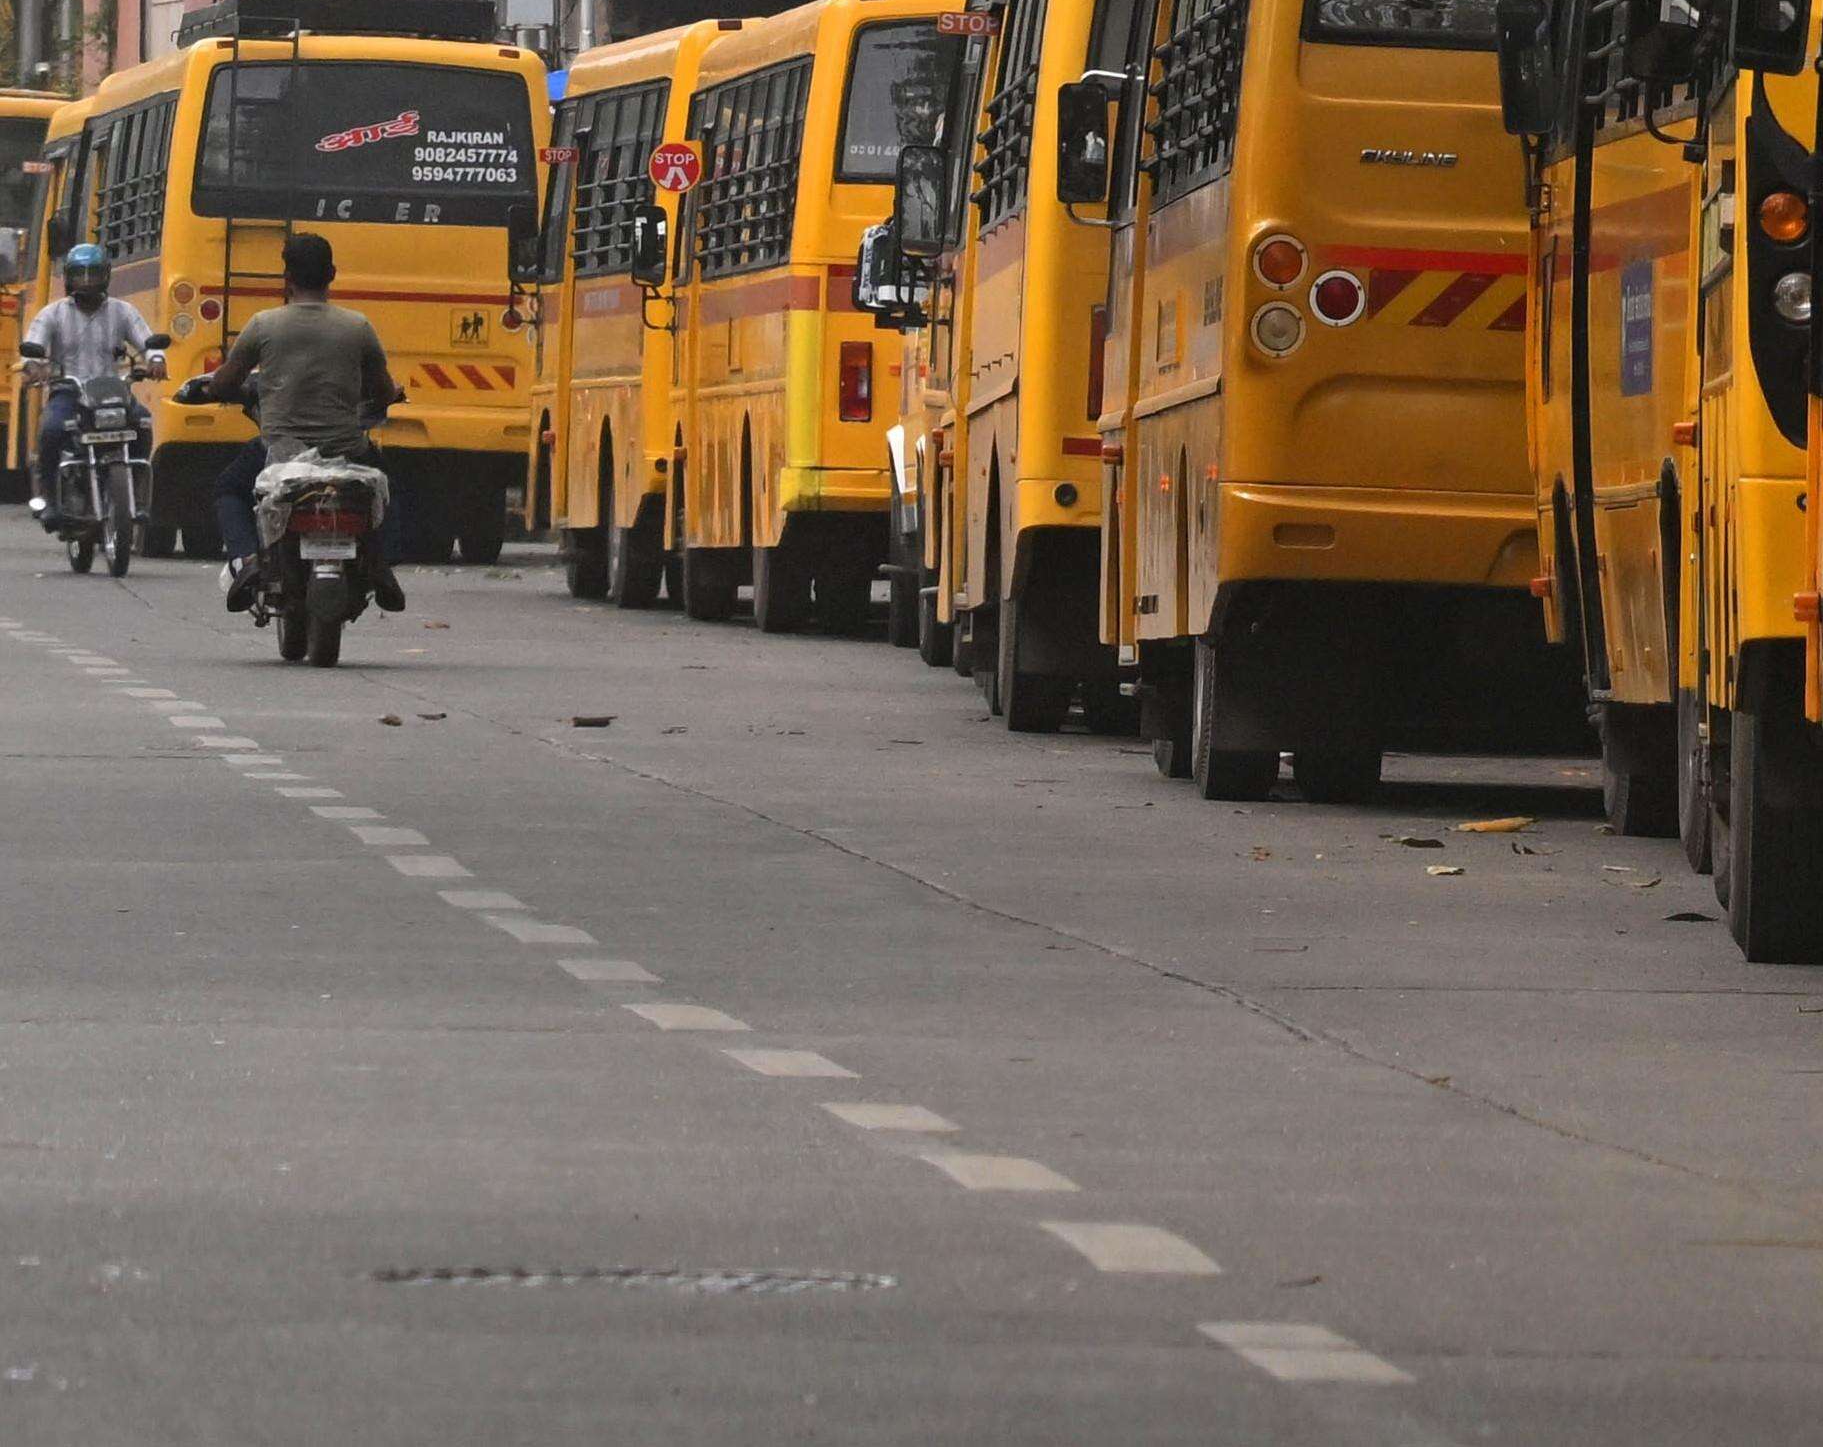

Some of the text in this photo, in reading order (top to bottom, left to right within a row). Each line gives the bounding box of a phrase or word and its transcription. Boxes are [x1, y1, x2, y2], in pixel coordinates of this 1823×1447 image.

[941, 13, 1000, 32] STOP
[427, 130, 504, 145] RAJKIRAN
[414, 147, 519, 164] 9082457774
[544, 150, 572, 162] STOP
[655, 152, 695, 165] STOP
[1360, 148, 1459, 168] SKYLINE
[412, 166, 517, 182] 9594777063
